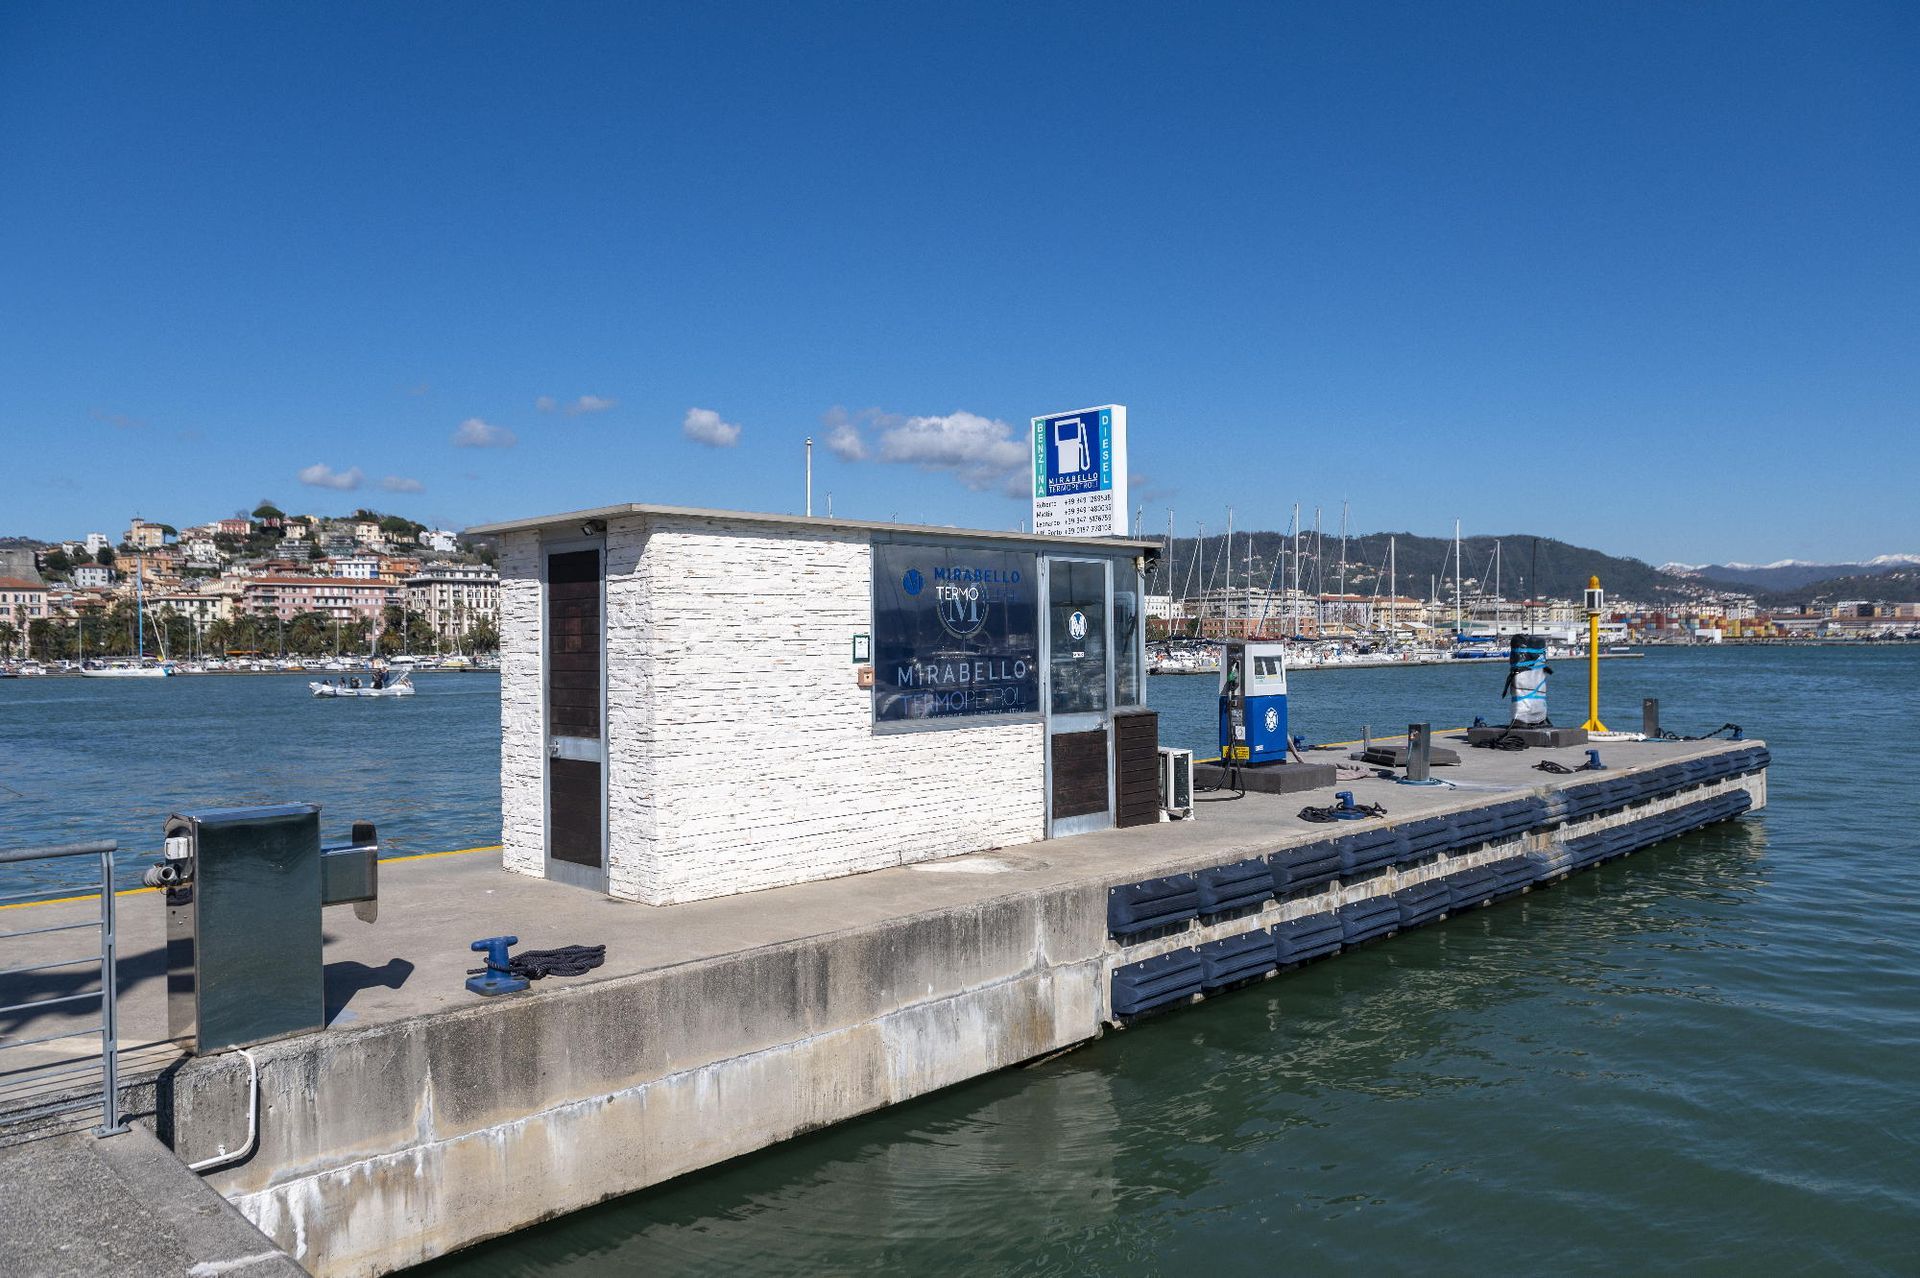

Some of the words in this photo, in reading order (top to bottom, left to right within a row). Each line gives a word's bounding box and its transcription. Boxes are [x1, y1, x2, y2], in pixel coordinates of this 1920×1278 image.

[1037, 423, 1045, 495] BENZINA
[1101, 415, 1110, 484] DIESEL
[1048, 472, 1098, 485] MIRABELLO
[934, 567, 1020, 584] MIRABELLO
[935, 586, 979, 601] TERMO
[897, 660, 1026, 687] MIRABELLO
